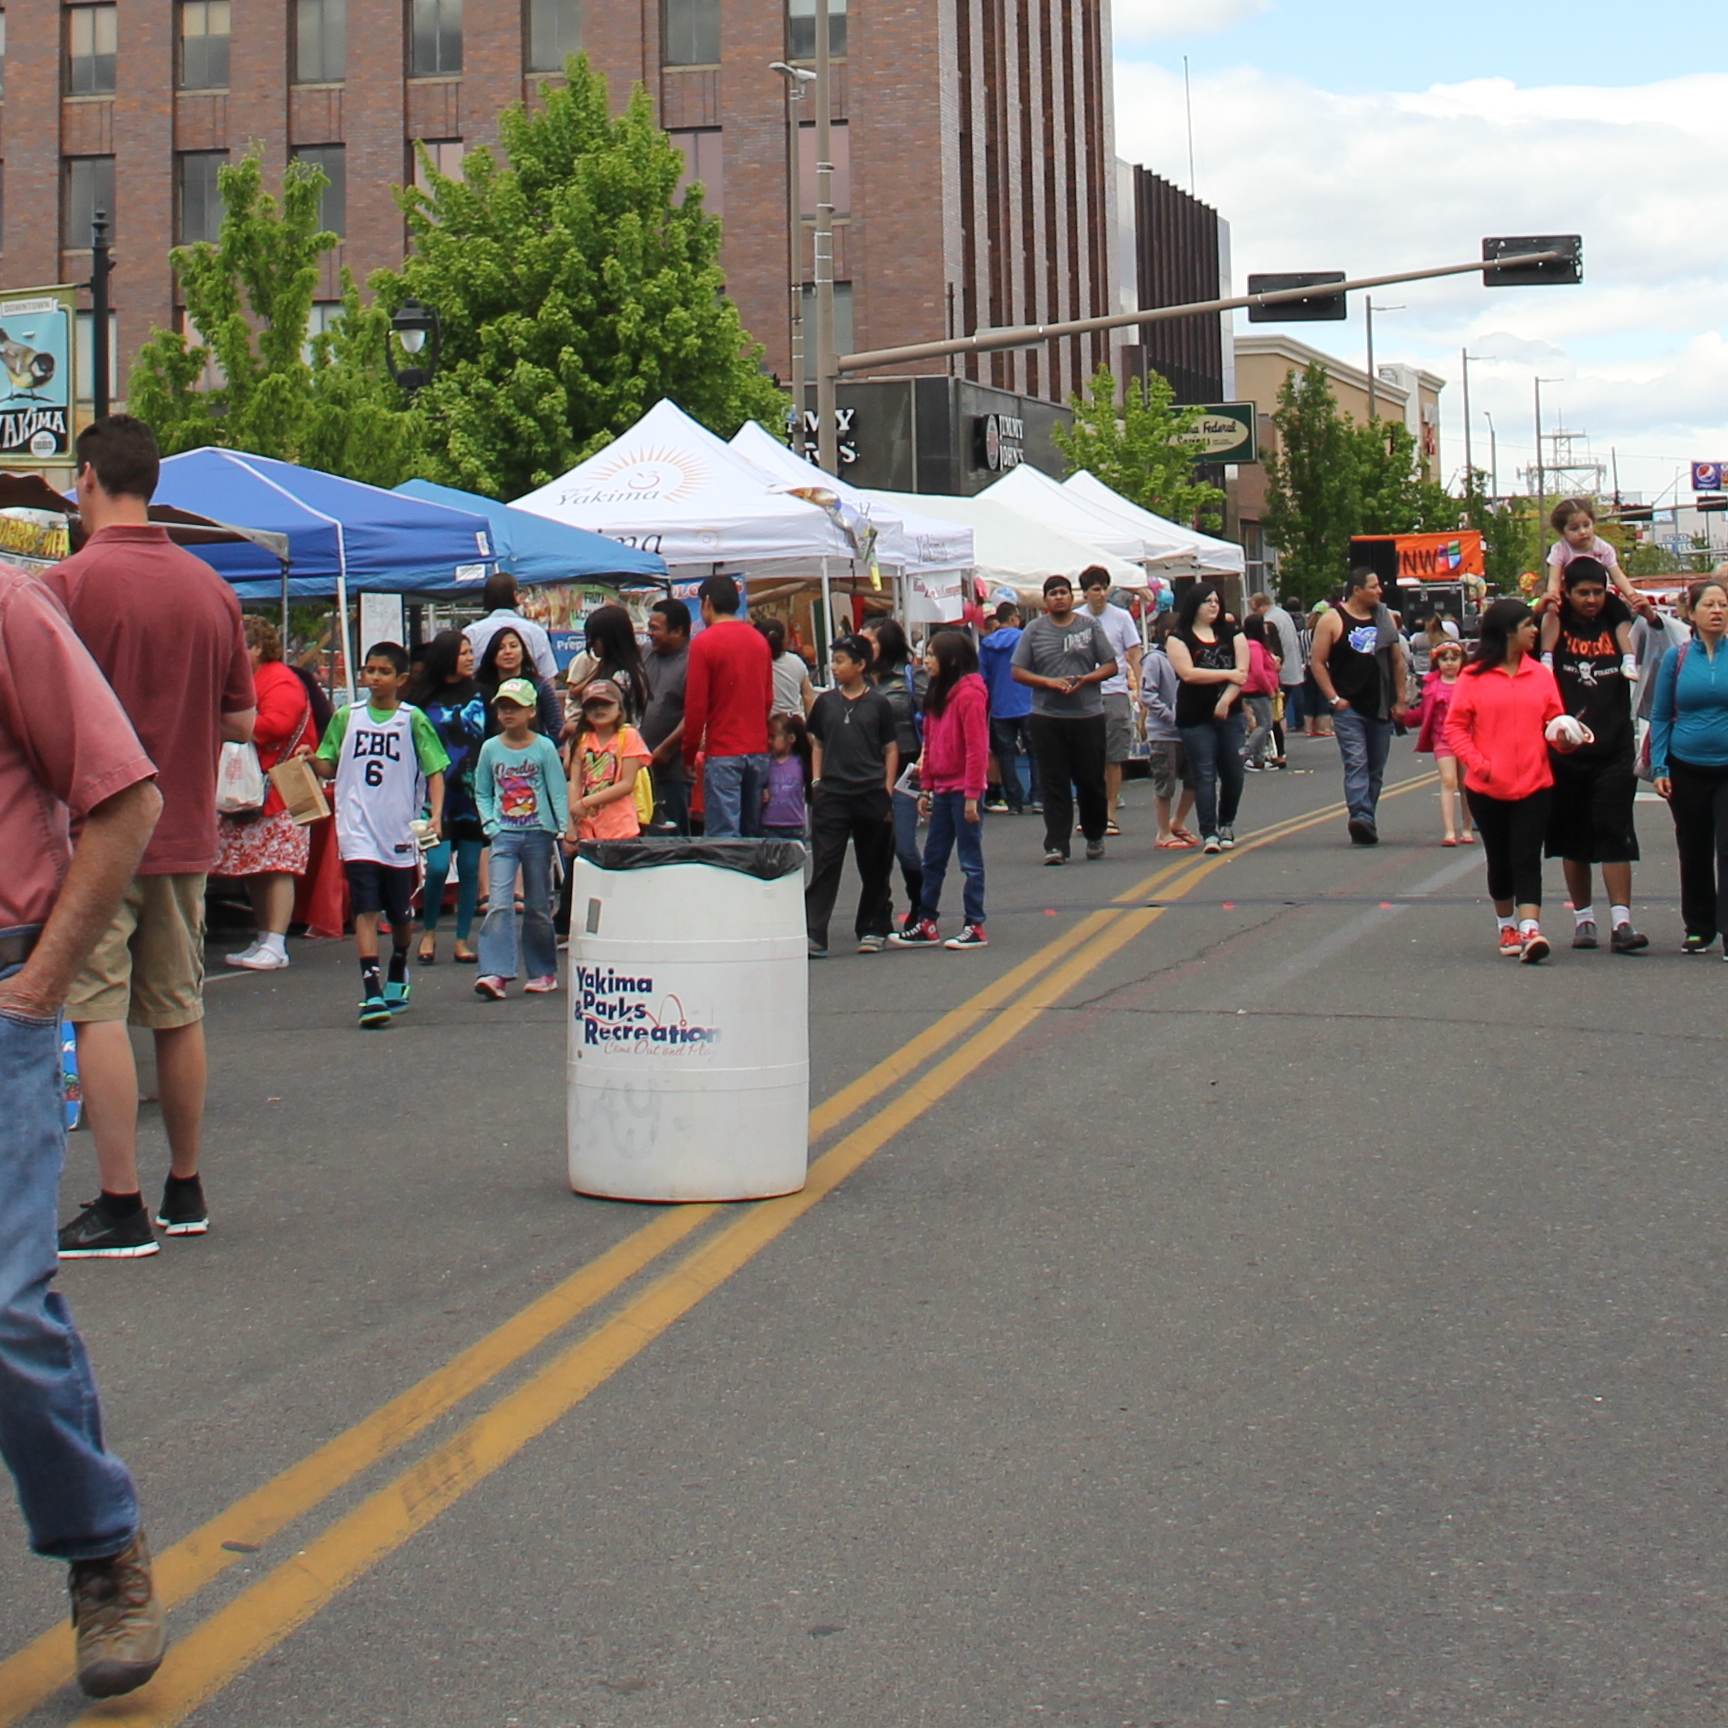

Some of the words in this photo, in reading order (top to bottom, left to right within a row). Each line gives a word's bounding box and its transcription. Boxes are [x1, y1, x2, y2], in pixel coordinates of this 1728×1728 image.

[4, 300, 51, 313] DOWNTOWN
[999, 414, 1024, 441] JIMMY
[1203, 420, 1236, 433] Federal
[557, 489, 660, 505] Yakima
[1398, 549, 1439, 575] NW
[354, 729, 400, 761] EBC
[365, 759, 384, 787] 6
[576, 965, 653, 995] Yakima
[574, 999, 584, 1021] &
[584, 989, 647, 1022] Parks
[584, 1018, 722, 1046] Recreation
[634, 1037, 660, 1055] Out
[662, 1042, 684, 1056] and
